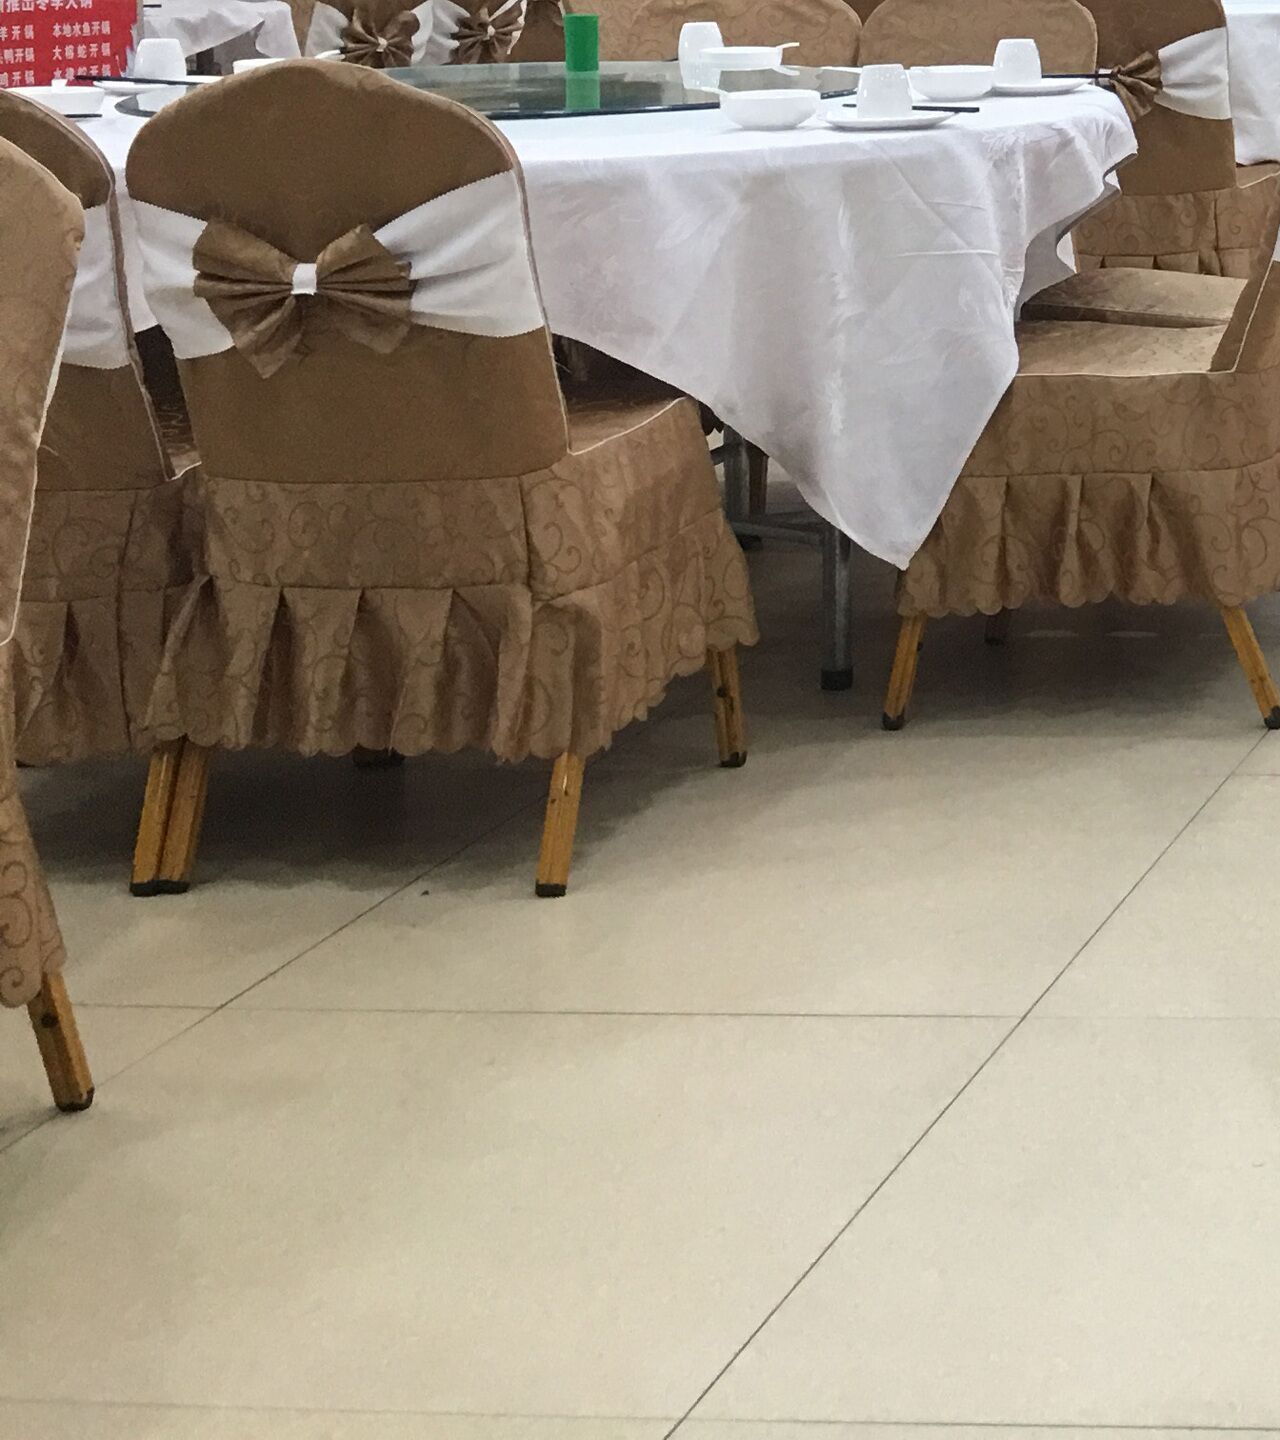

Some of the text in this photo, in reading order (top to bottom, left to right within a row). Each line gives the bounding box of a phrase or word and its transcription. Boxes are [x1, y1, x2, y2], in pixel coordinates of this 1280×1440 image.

[52, 20, 111, 38] 本地水鱼开锅
